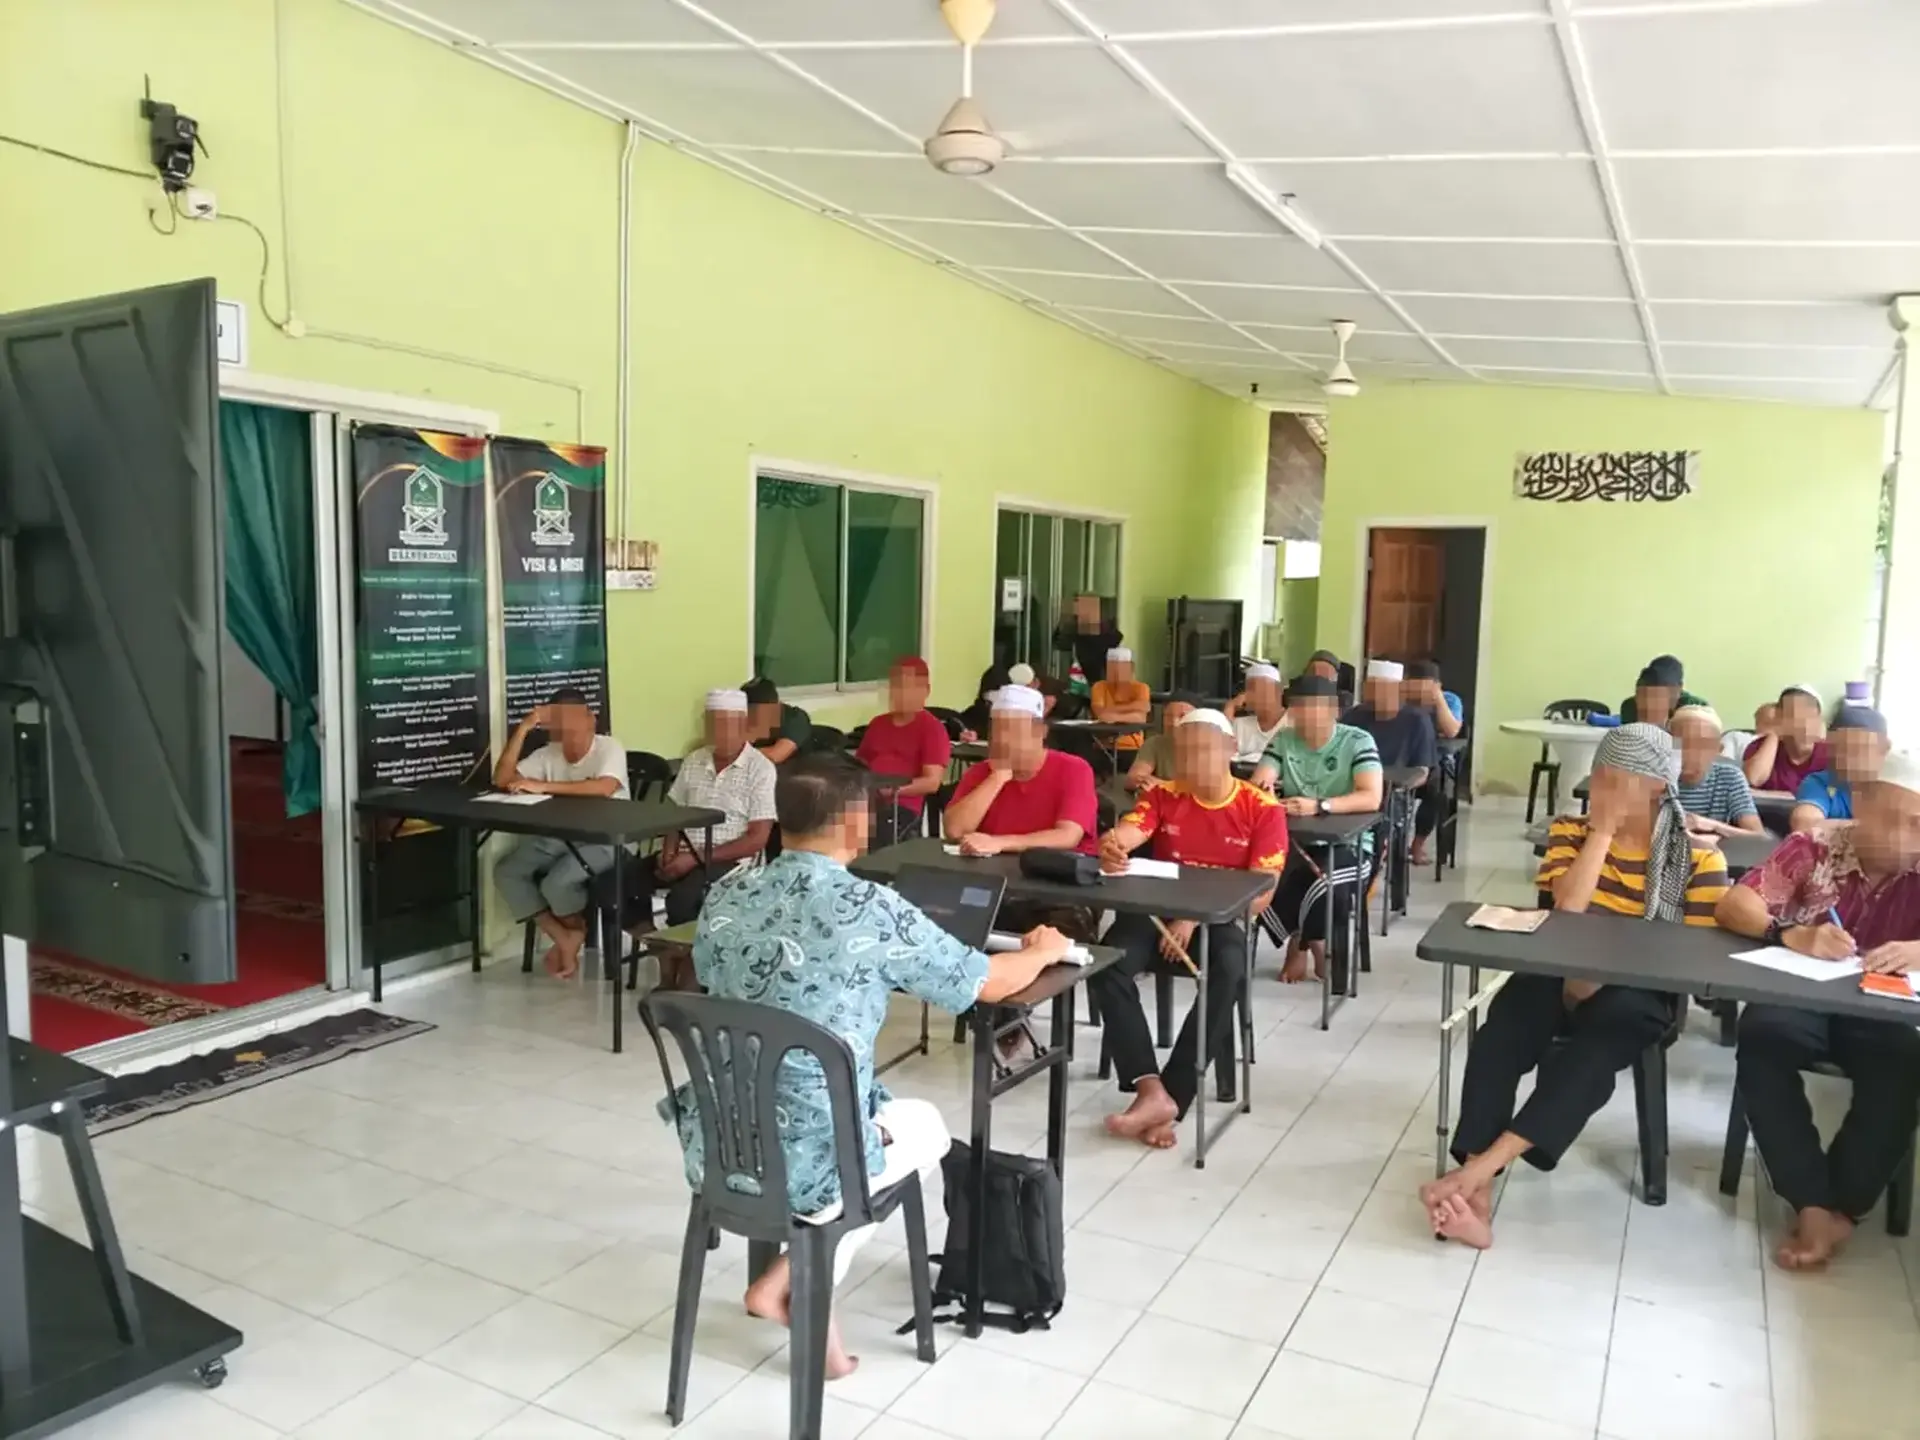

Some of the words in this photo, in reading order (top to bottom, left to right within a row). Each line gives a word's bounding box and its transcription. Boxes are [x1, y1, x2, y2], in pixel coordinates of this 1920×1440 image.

[521, 557, 546, 572] VISI
[547, 557, 558, 572] &
[560, 557, 584, 572] MISI
